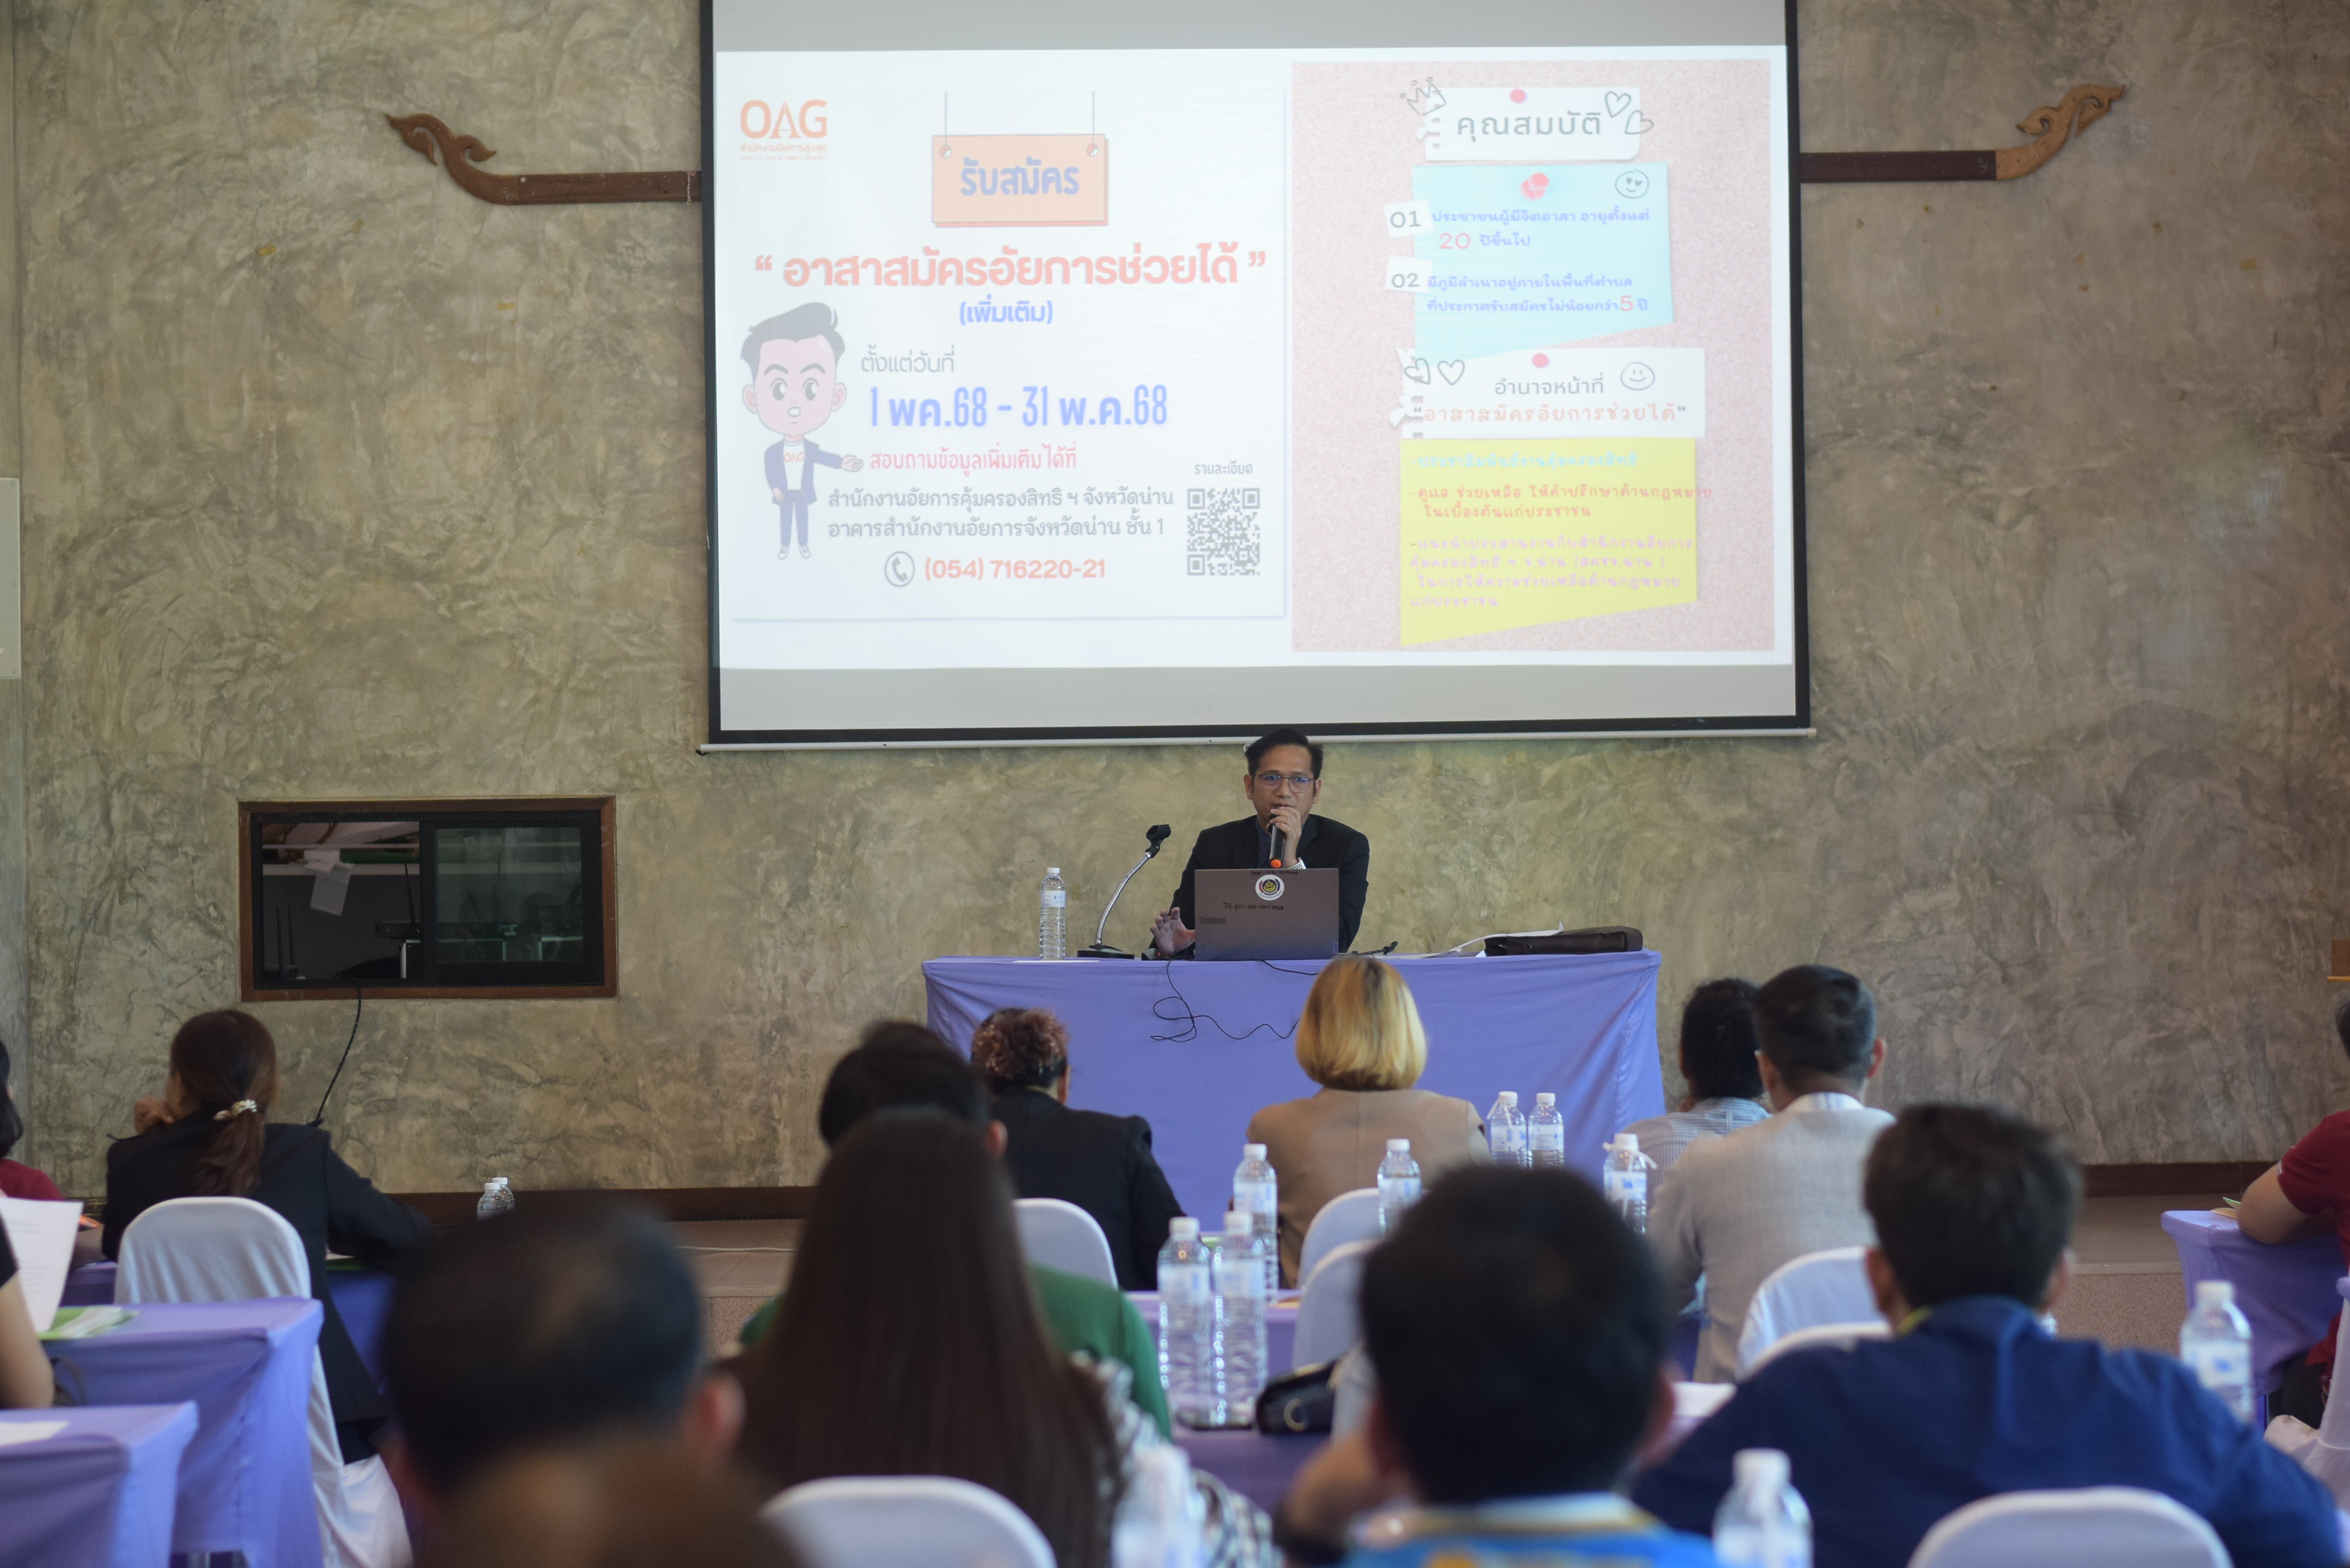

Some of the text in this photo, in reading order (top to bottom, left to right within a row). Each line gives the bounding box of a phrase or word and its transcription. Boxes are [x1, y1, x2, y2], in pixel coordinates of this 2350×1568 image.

[740, 99, 827, 139] OAG
[1457, 111, 1602, 143] คุณสมบัติ
[960, 156, 1079, 197] รับสมัคร
[1390, 210, 1421, 228] 01
[1580, 205, 1650, 225] อายุตั้งแต่
[1439, 231, 1530, 250] 20 ปีขึ้นไป
[782, 241, 1238, 287] อาสาสมัครอัยการช่วยได้
[1391, 272, 1420, 289] 02
[959, 294, 1053, 326] (เพิ่มเติม)
[861, 343, 955, 373] ตั้งแต่วันที่
[1495, 372, 1604, 395] อำนาจหน้าที่
[1022, 386, 1048, 427] 31
[1194, 460, 1253, 475] รายละเอียด
[828, 486, 1063, 512] สำนักงานอัยการคุ้มครองสิทธิ
[1083, 486, 1174, 506] จังหวัดน่าน
[828, 506, 1163, 538] อาคารสำนักงานอัยการจังหวัดน่าน ชั้น 1
[925, 557, 1105, 581] (054) 716220-21
[1199, 916, 1226, 925] ThinkBook
